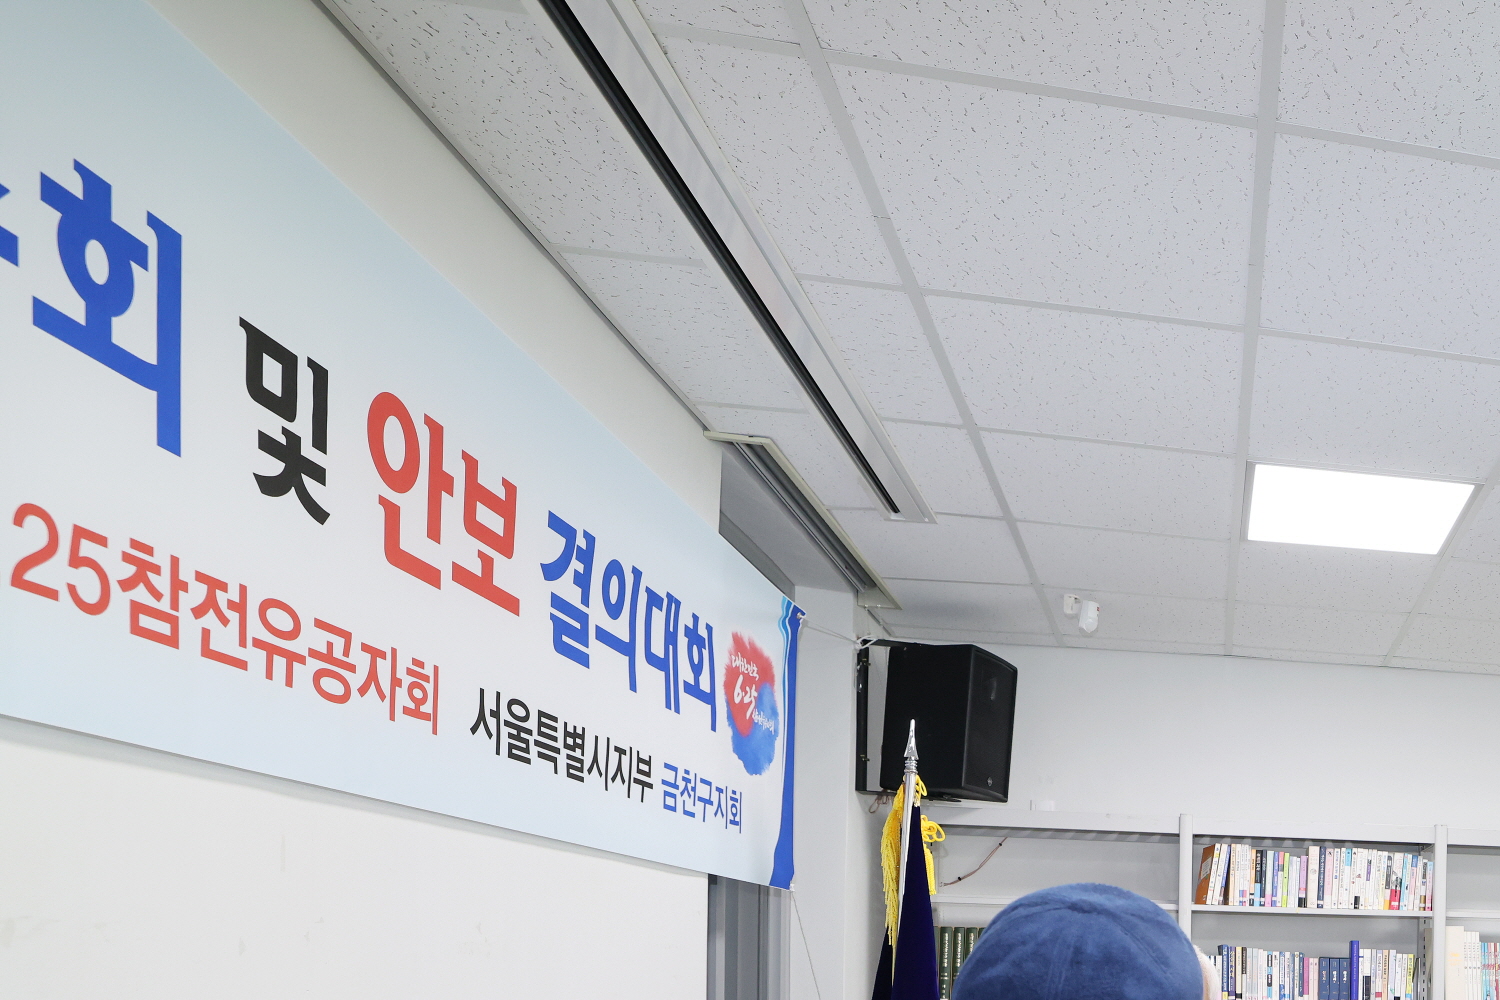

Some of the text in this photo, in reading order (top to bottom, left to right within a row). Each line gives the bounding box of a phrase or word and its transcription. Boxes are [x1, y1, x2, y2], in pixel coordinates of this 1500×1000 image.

[0, 158, 717, 731] 회 및 안보 결의대회
[10, 502, 743, 834] 25참전유공자회 서울특별시지부 금천구지회
